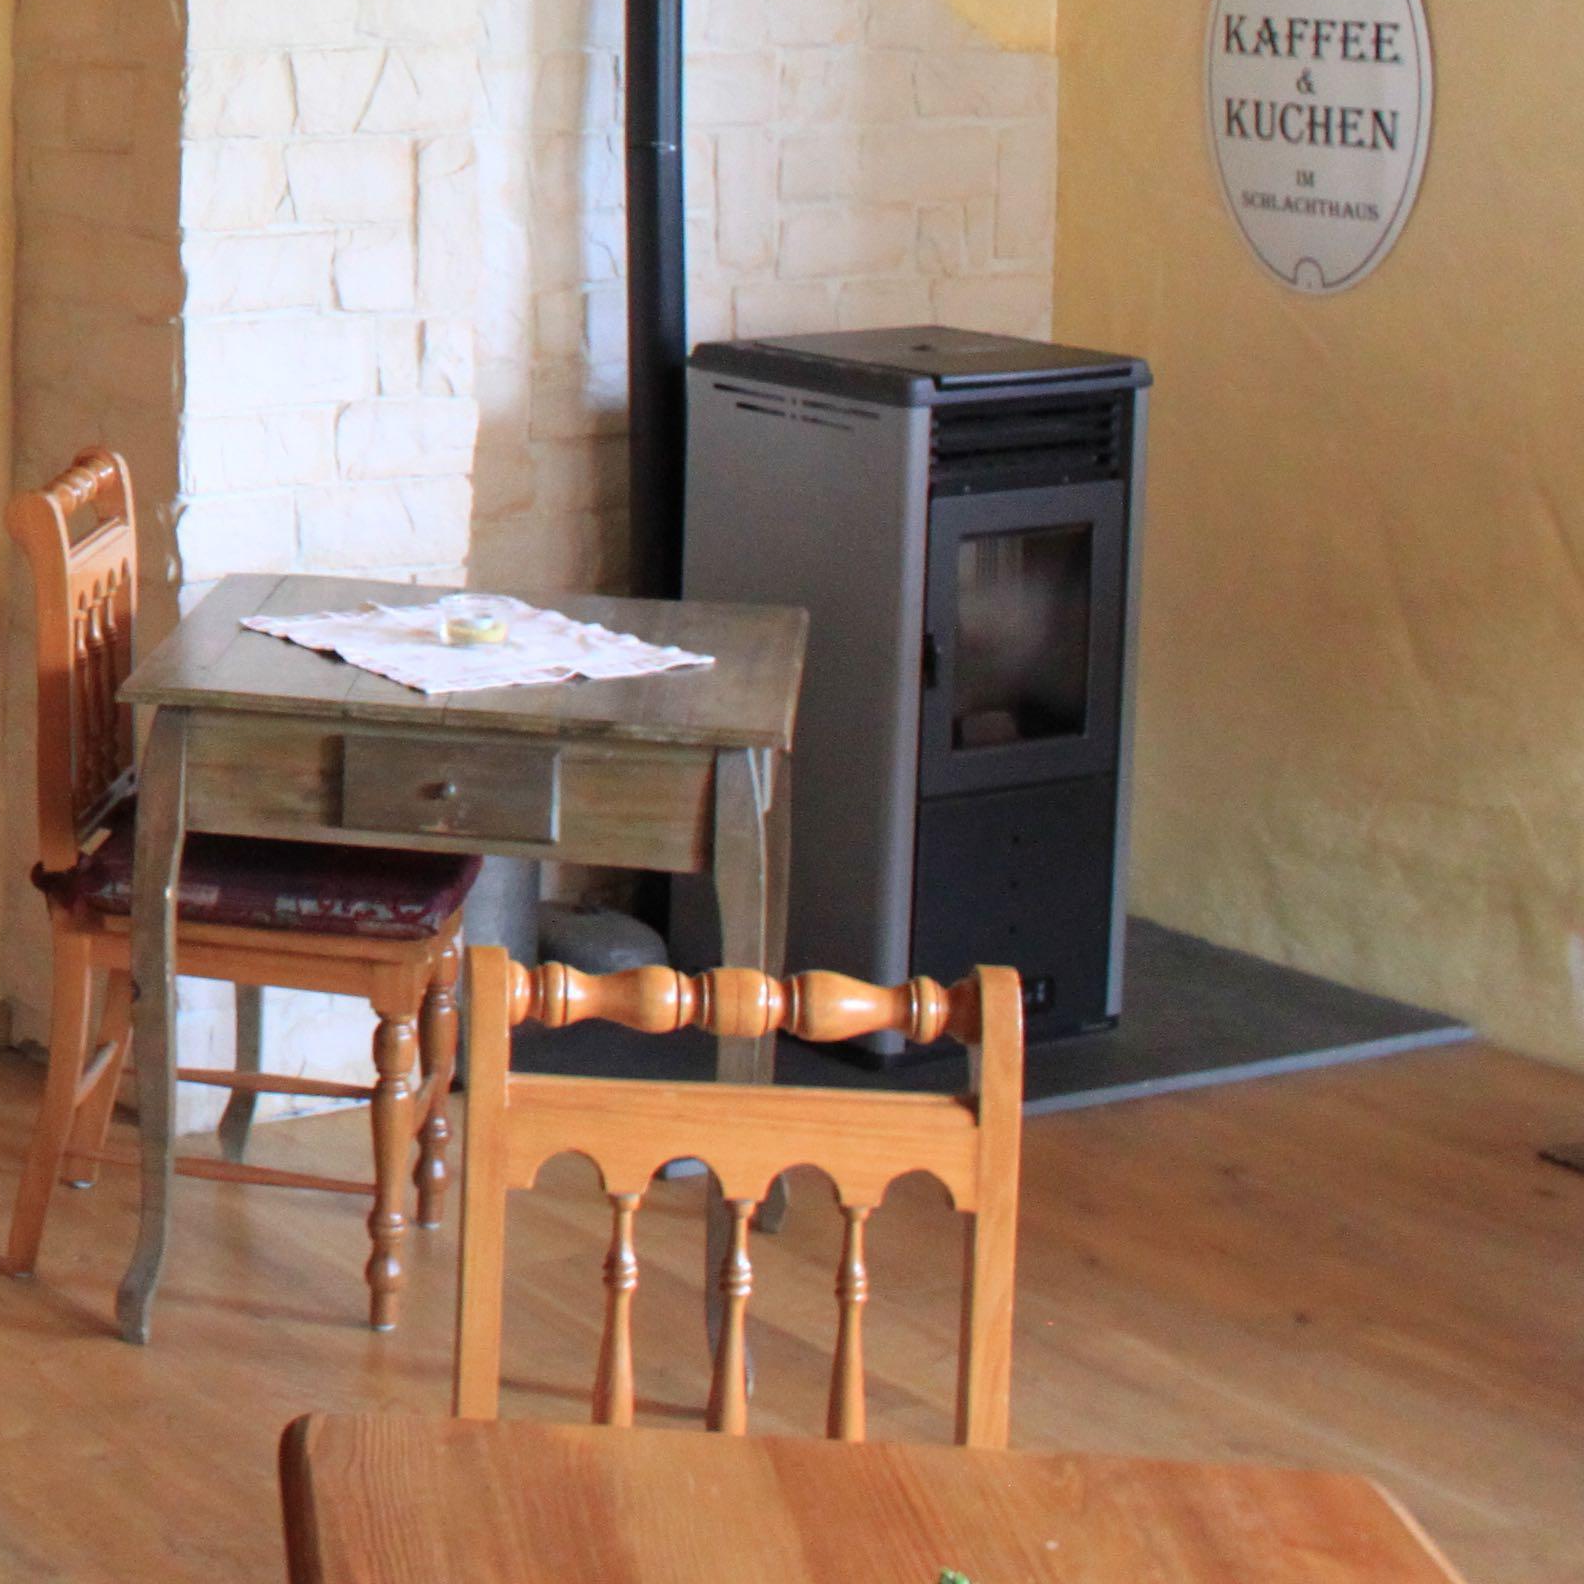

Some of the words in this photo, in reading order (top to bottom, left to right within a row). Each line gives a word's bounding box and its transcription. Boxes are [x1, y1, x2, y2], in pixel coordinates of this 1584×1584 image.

[1224, 15, 1401, 63] KAFFEE
[1296, 68, 1315, 95] &
[1225, 98, 1400, 150] KUCHEN
[1295, 169, 1315, 188] IM
